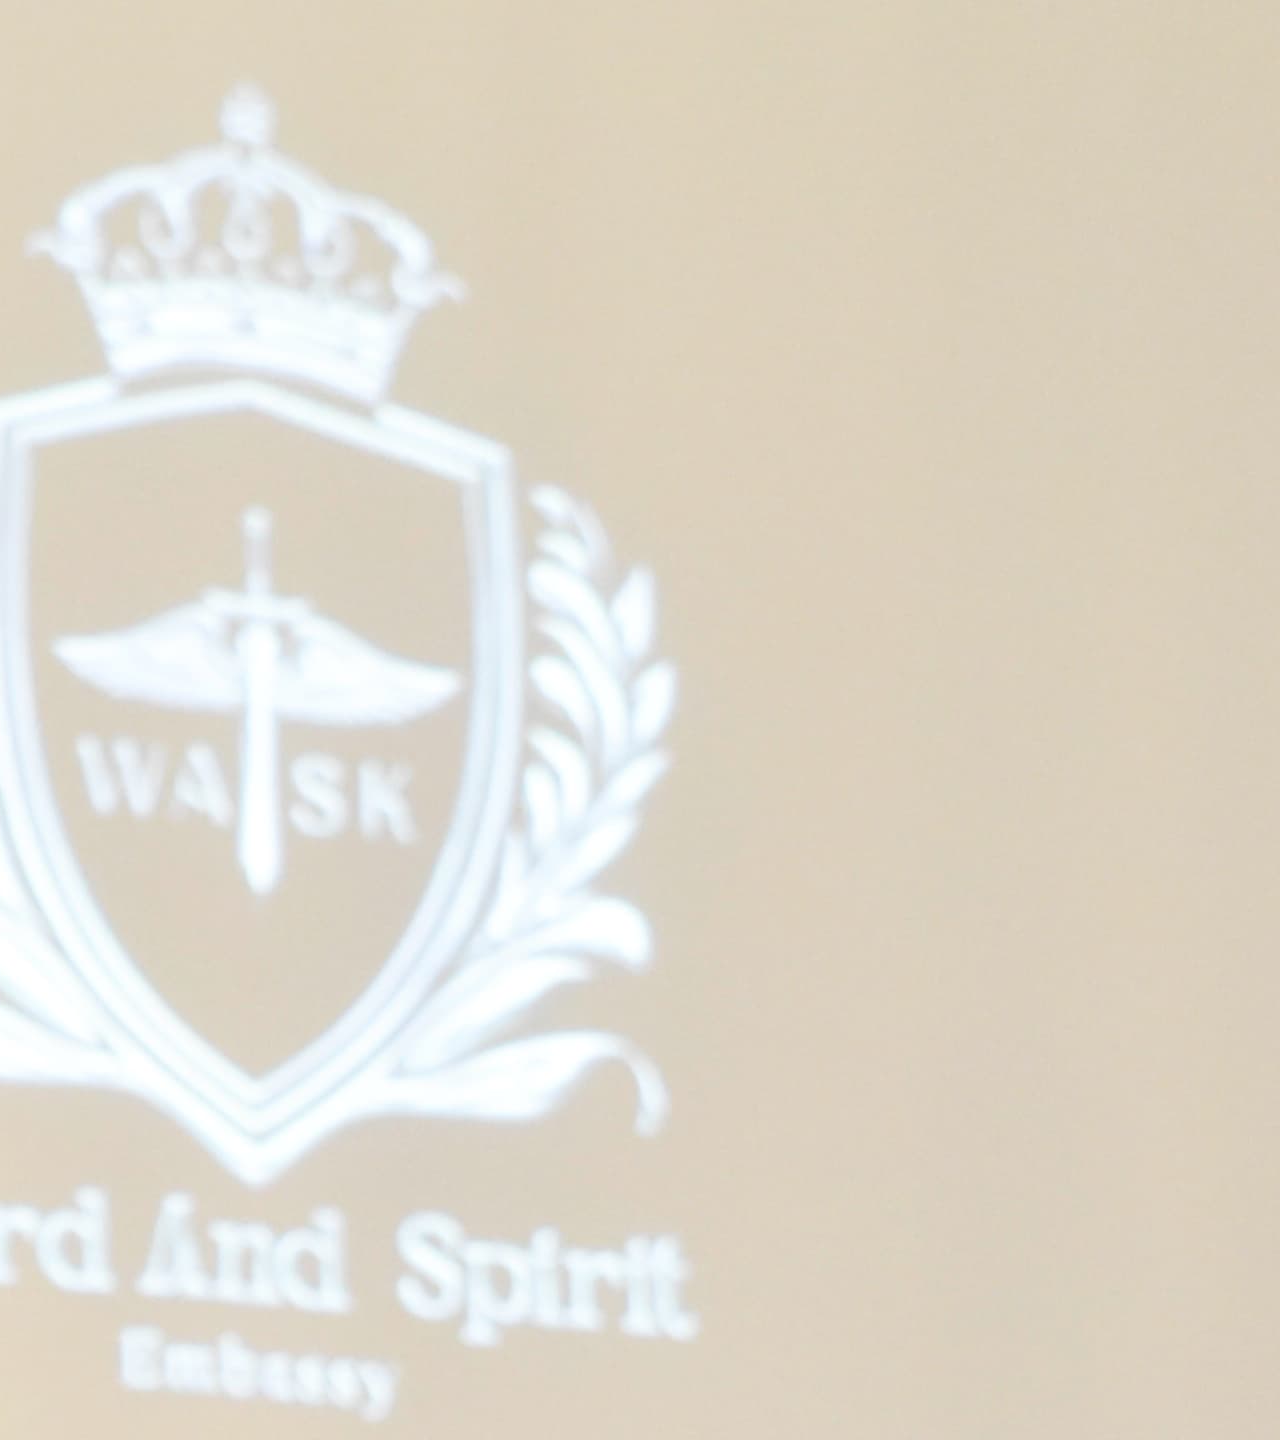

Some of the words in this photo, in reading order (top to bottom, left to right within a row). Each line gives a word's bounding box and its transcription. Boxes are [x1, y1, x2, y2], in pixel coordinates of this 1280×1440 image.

[135, 1190, 354, 1315] And
[395, 1210, 700, 1348] Spirit
[117, 1323, 400, 1422] Embassy
